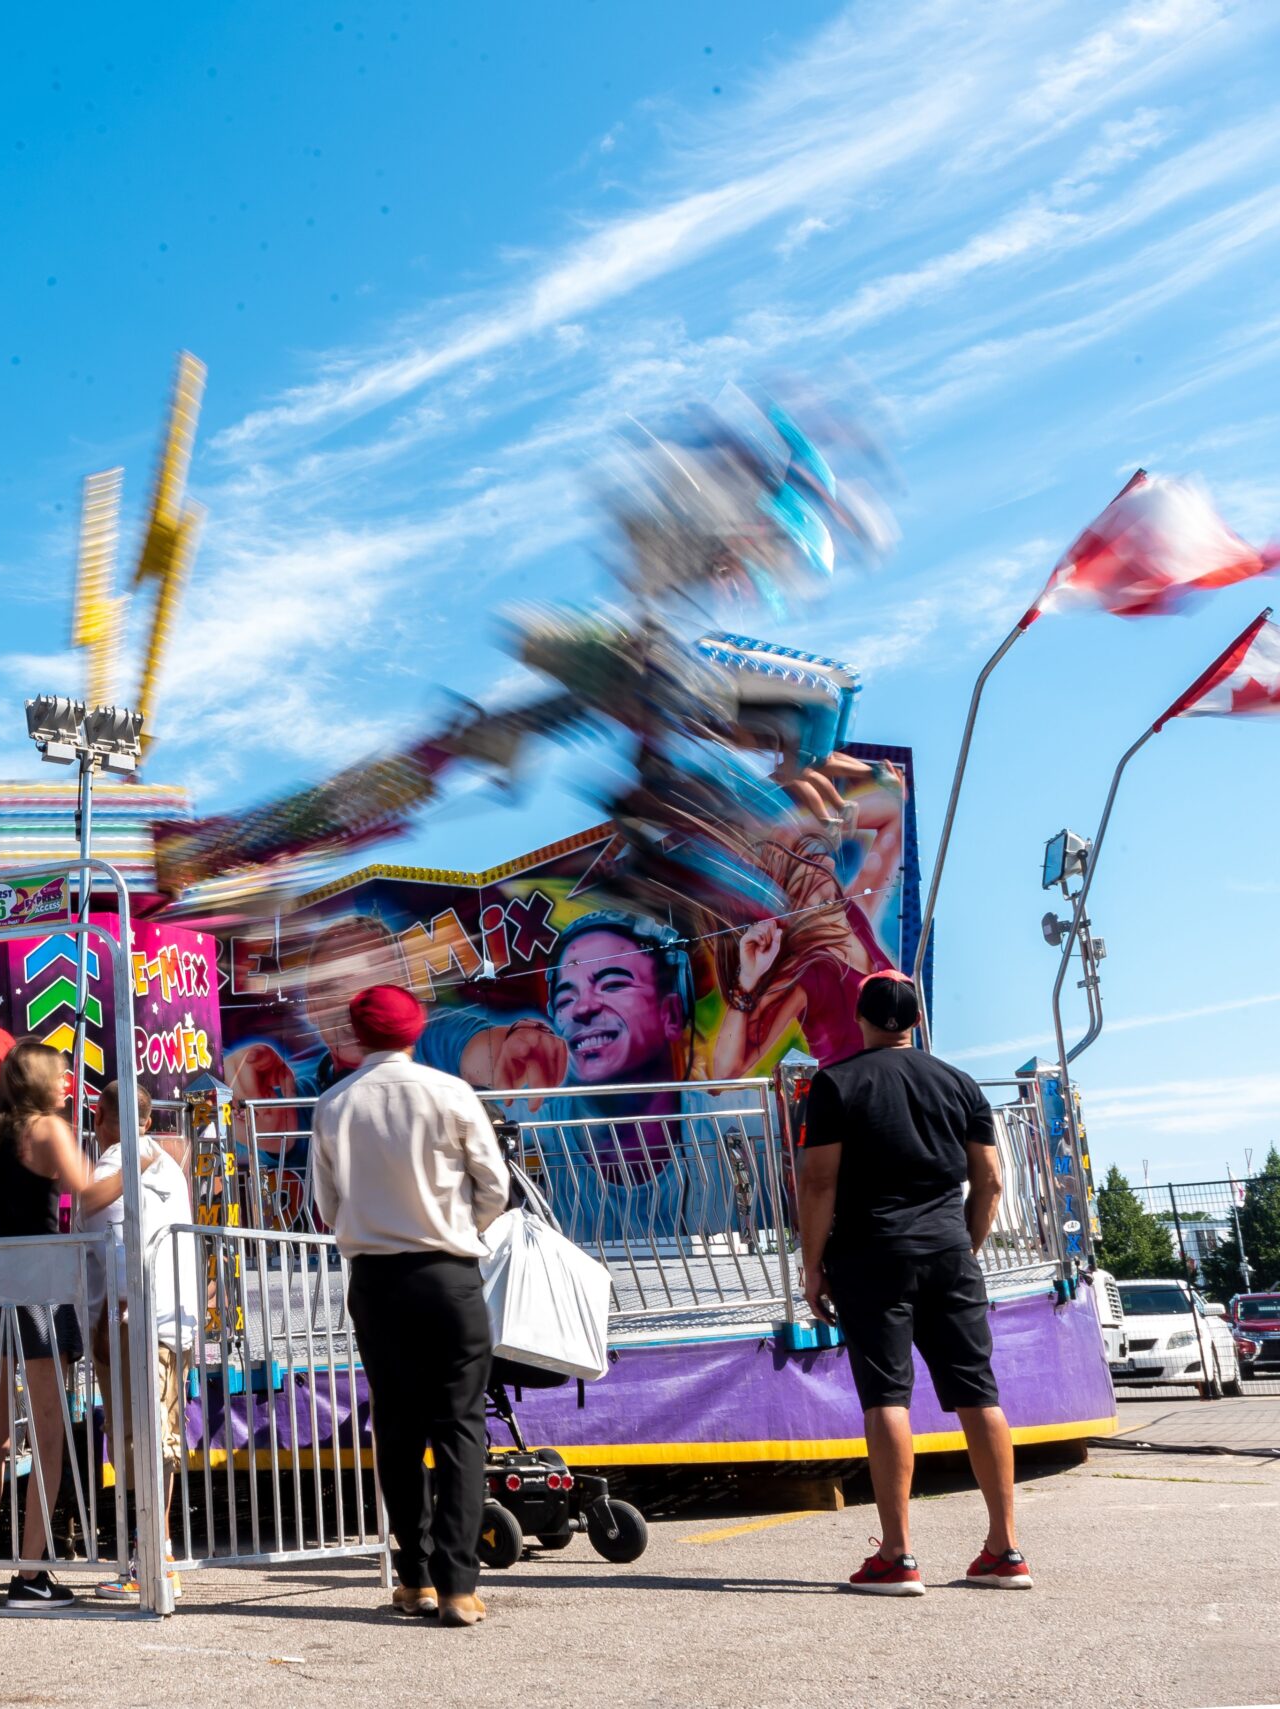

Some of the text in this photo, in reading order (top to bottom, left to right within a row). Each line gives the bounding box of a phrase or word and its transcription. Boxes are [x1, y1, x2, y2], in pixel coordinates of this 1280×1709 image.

[25, 891, 63, 912] EXPRESS
[35, 901, 61, 914] ACCESS
[134, 1022, 213, 1076] POWER
[1045, 1079, 1082, 1253] REMIX
